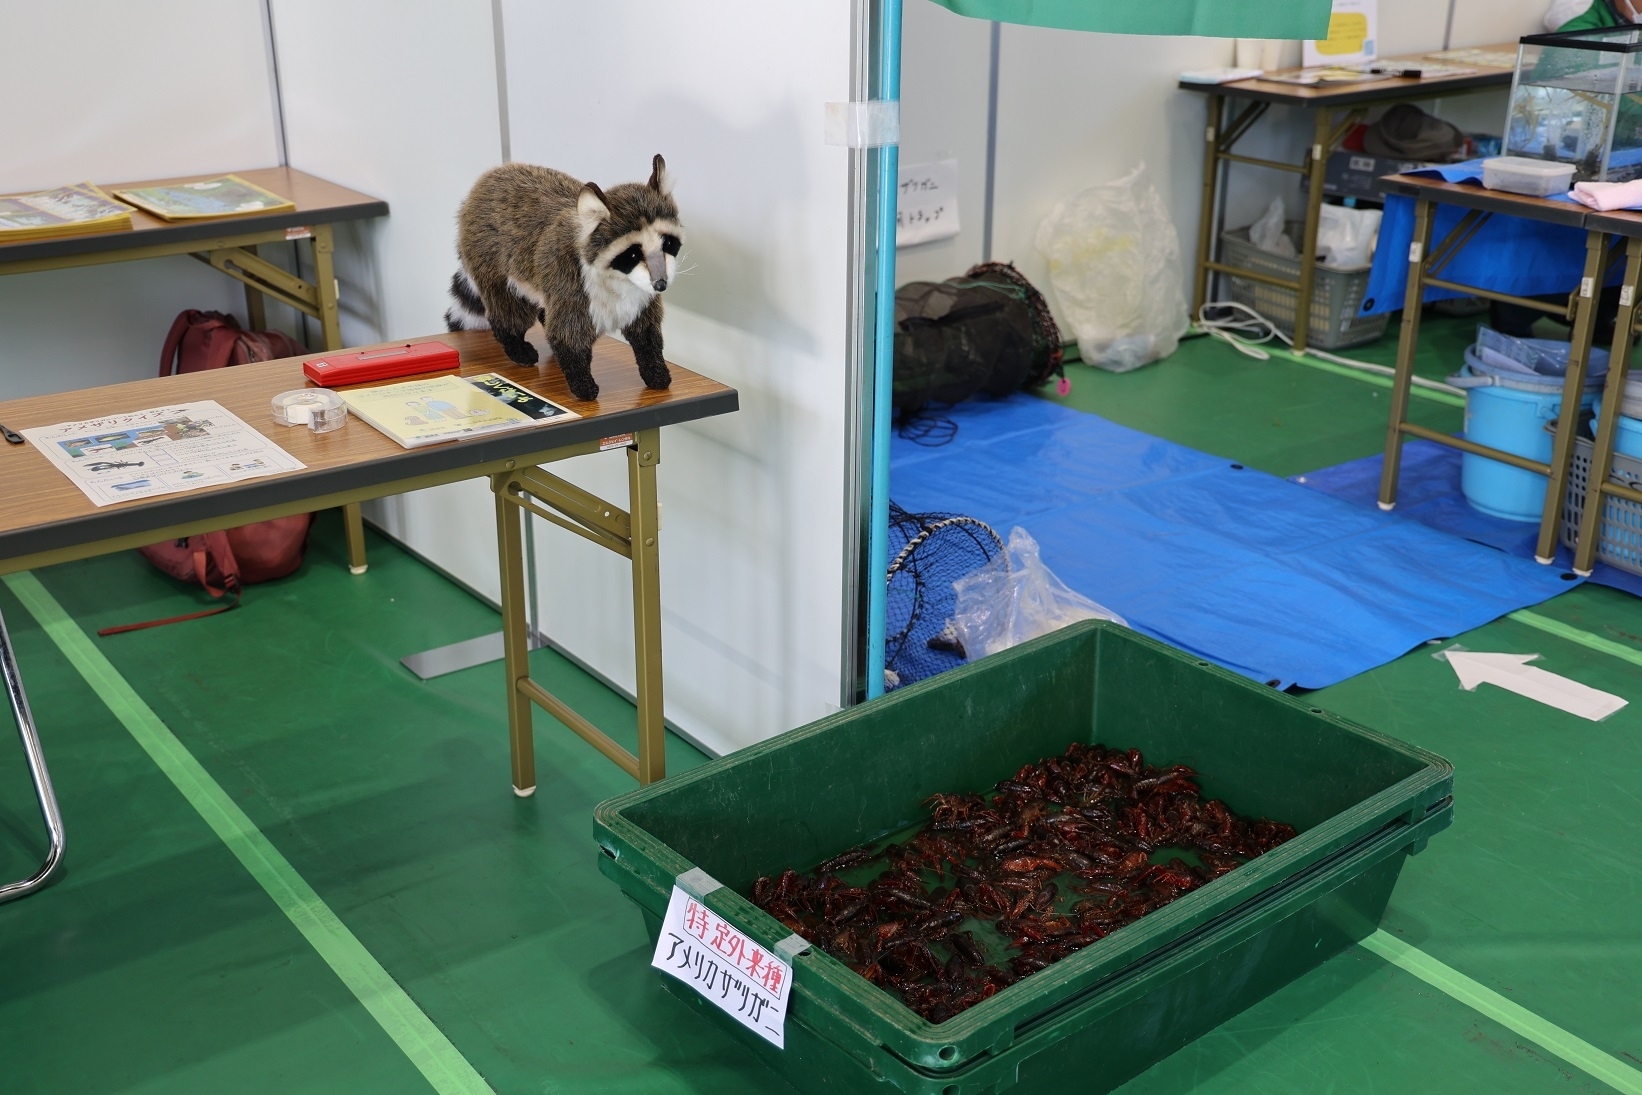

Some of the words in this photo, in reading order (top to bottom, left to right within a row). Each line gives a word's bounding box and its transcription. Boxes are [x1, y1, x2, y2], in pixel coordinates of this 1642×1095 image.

[667, 933, 780, 1036] アメリカザリガニ
[686, 903, 782, 993] 特定外来種
